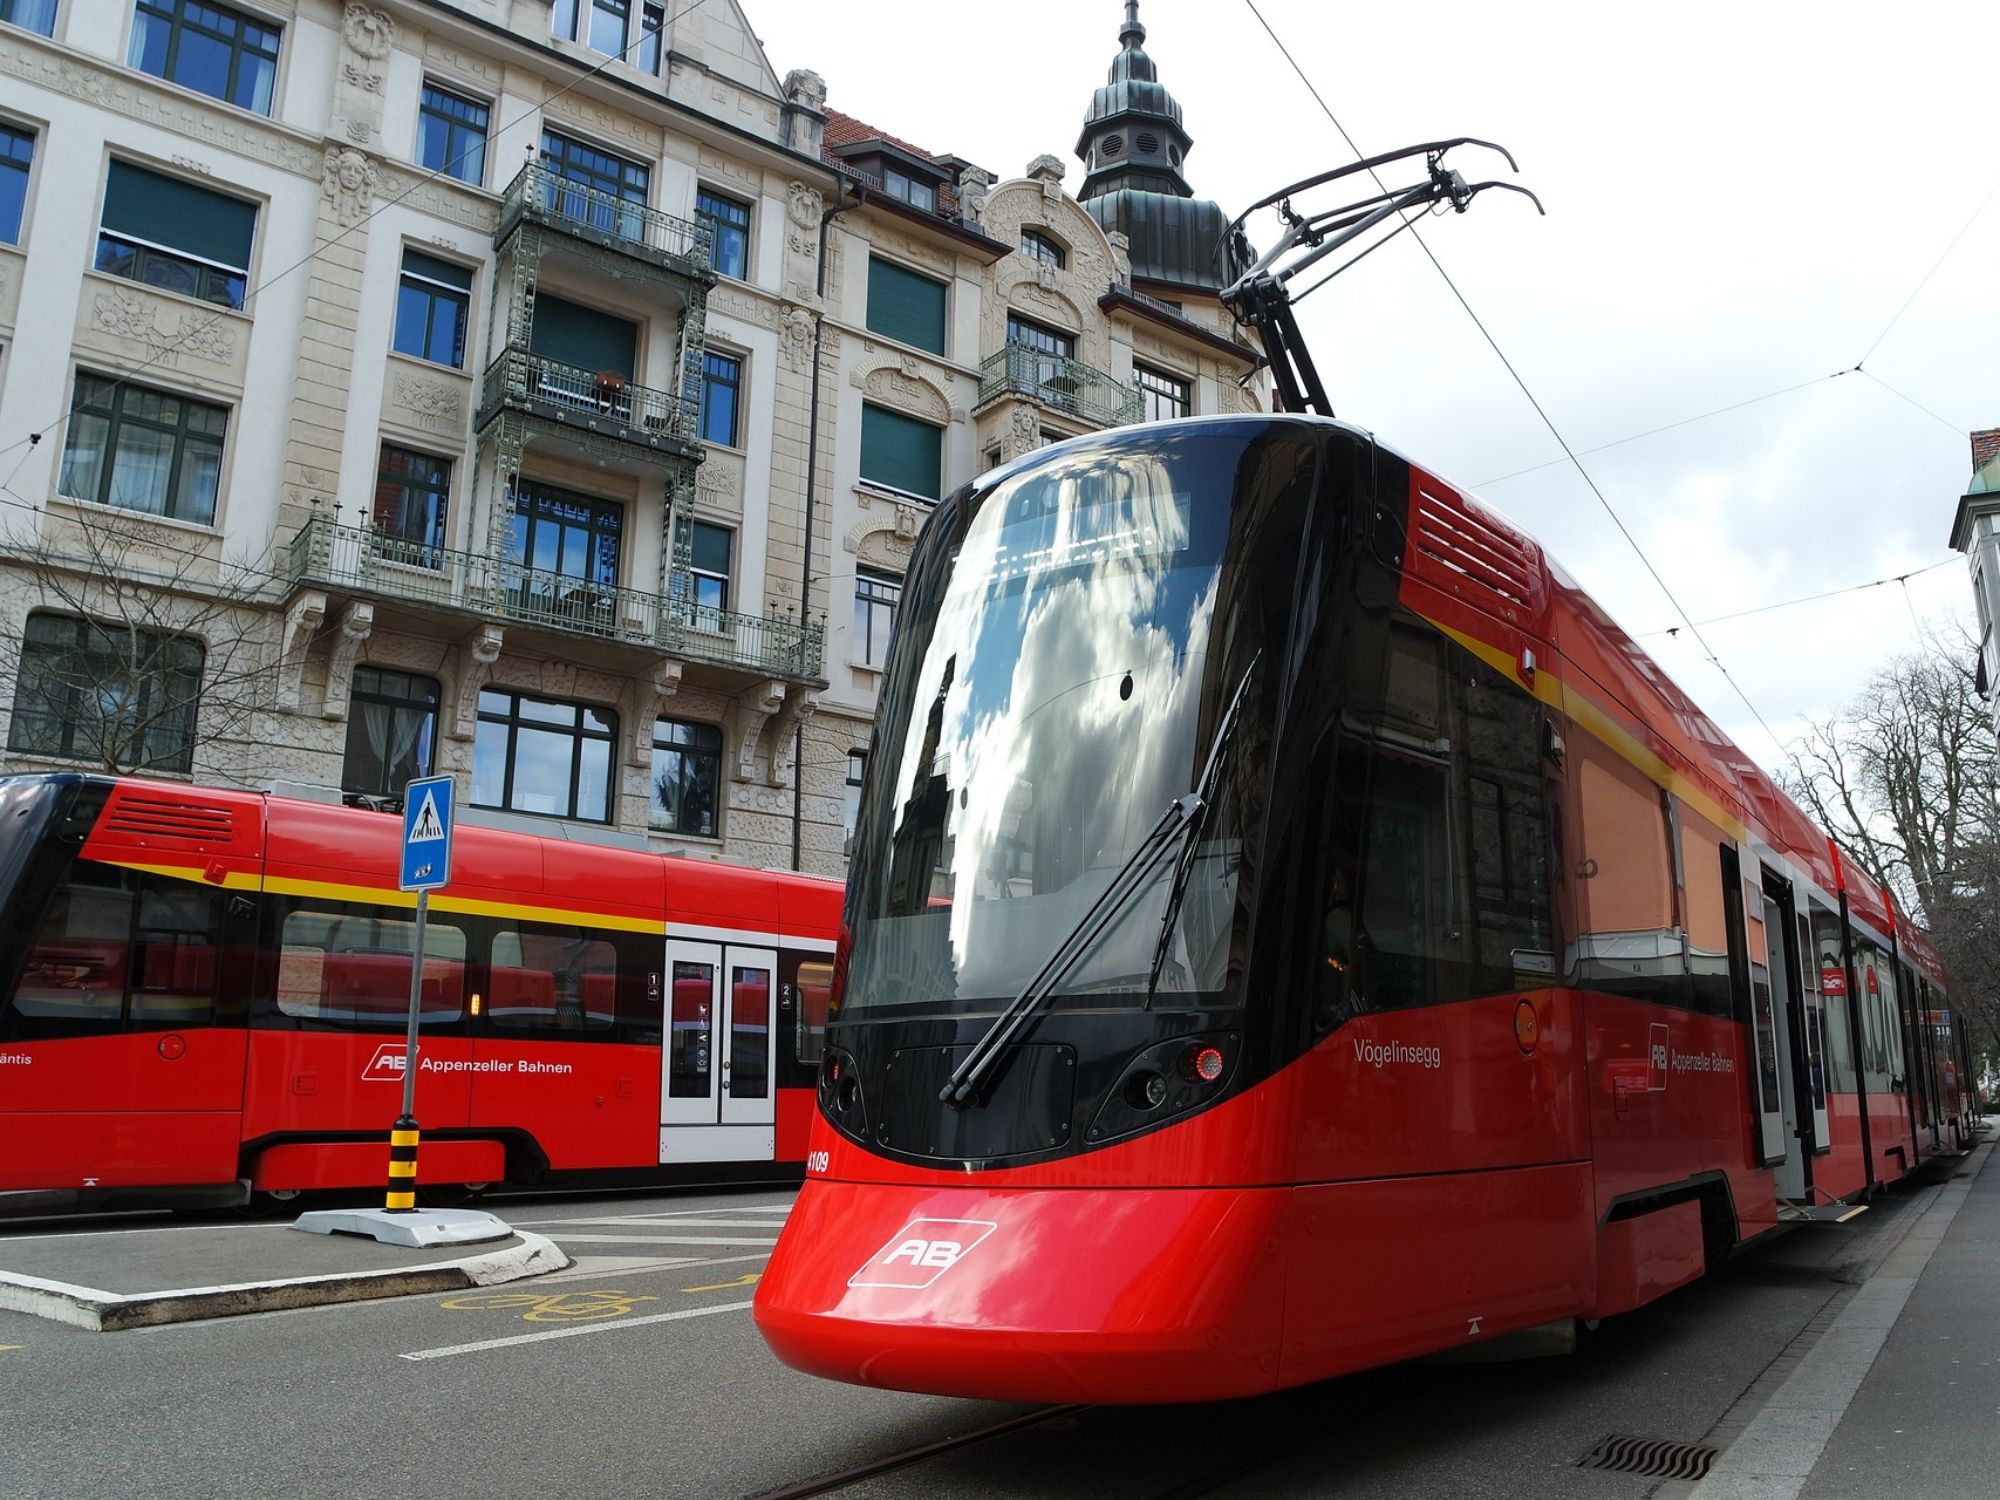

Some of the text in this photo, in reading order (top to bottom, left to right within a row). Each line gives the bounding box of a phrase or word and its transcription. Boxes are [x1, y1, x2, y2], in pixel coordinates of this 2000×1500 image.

[651, 974, 656, 984] 1
[783, 985, 790, 995] 2
[1353, 1038, 1441, 1068] Vögelinsegg
[1651, 1044, 1735, 1074] AB Appenzeller Bahnen
[420, 1057, 513, 1073] Appenzeller
[518, 1060, 572, 1074] Bahnen
[881, 1239, 961, 1268] AB
